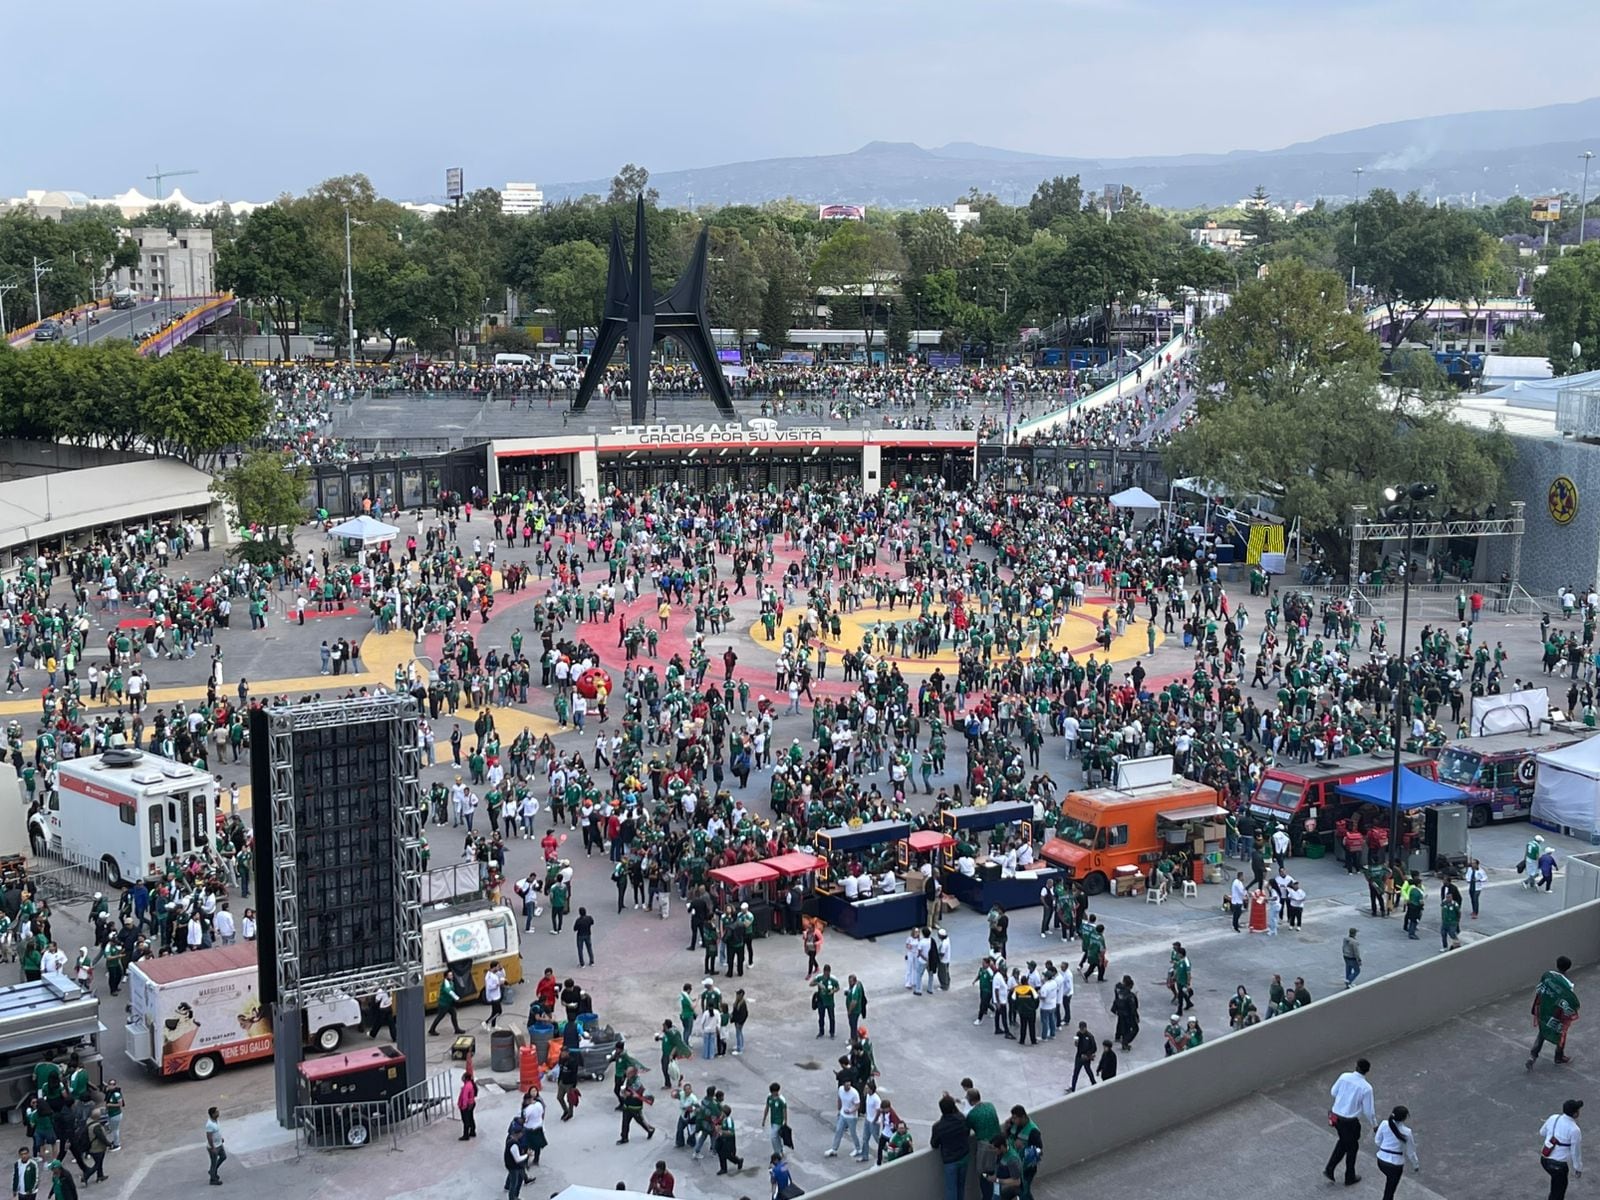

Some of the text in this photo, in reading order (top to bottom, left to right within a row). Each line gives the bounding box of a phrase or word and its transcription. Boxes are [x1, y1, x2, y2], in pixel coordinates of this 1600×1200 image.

[639, 431, 822, 444] GRACIAS POR SU VISITA
[239, 1045, 249, 1056] SU
[249, 1040, 270, 1052] GALLO
